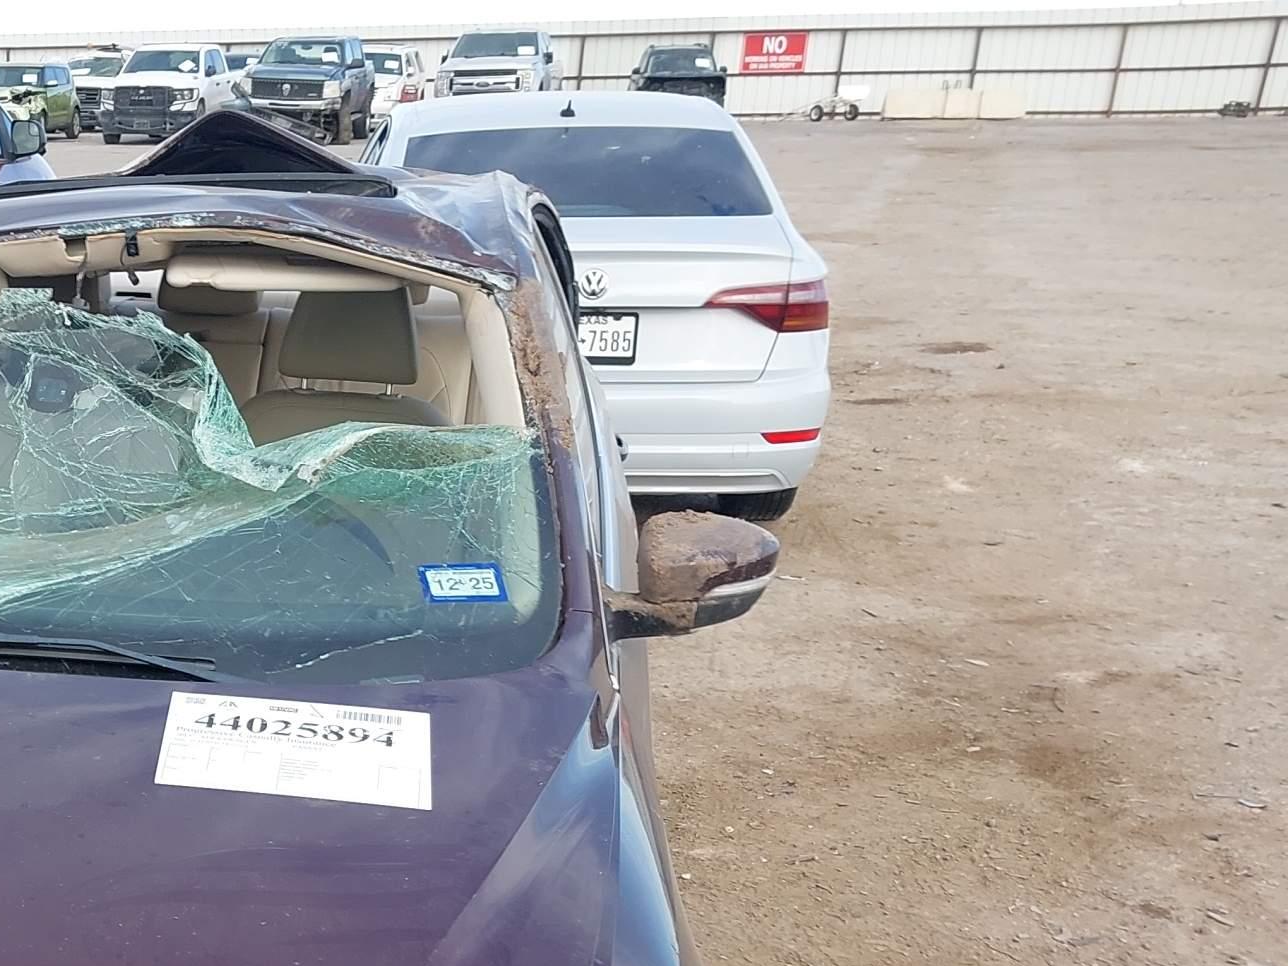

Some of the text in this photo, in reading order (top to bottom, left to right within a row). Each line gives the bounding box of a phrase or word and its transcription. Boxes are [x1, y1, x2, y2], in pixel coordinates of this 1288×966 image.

[762, 36, 787, 54] NO
[578, 315, 608, 325] EXAS
[588, 330, 632, 352] 7585
[469, 576, 494, 590] 25
[194, 713, 394, 747] 44025894
